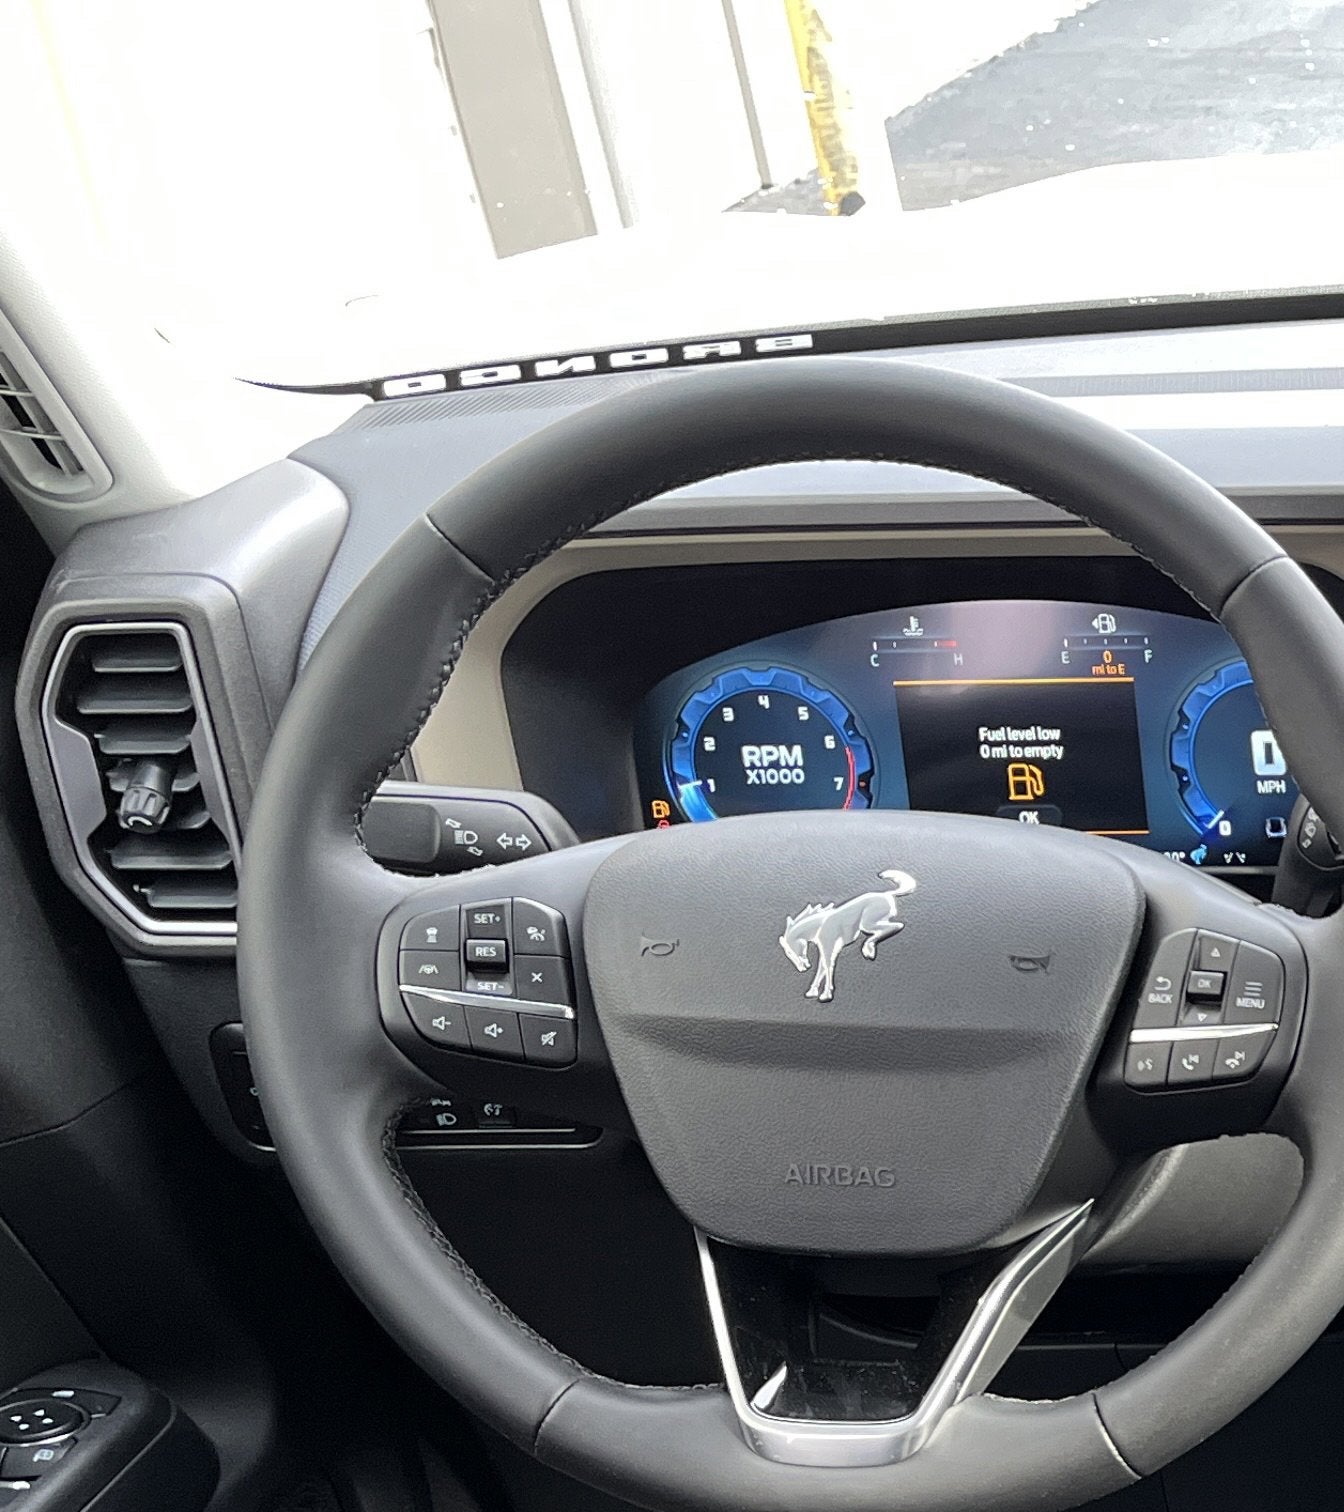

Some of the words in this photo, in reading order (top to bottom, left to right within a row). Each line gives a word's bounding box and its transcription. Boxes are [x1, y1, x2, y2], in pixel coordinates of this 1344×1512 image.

[870, 653, 880, 667] C
[954, 654, 963, 665] H
[1061, 650, 1071, 664] E
[1103, 649, 1113, 664] 0
[1144, 649, 1153, 664] F
[1092, 663, 1105, 676] mi
[1106, 663, 1117, 675] to
[1118, 662, 1125, 676] E
[758, 695, 770, 709] 4
[722, 707, 735, 722] 3
[797, 706, 809, 721] 5
[979, 726, 1006, 742] Fuel
[1006, 726, 1036, 741] level
[1036, 725, 1061, 741] low
[703, 737, 716, 751] 2
[824, 735, 836, 749] 6
[741, 744, 804, 768] RPM
[980, 744, 990, 759] 0
[991, 744, 1008, 759] mi
[1008, 744, 1023, 759] to
[1024, 744, 1065, 760] empty
[746, 768, 805, 786] X1000
[833, 777, 844, 791] 7
[707, 778, 716, 793] 1
[1256, 780, 1287, 795] MPH
[1019, 810, 1039, 824] OK
[1219, 820, 1232, 837] 0
[475, 946, 497, 958] RES
[1197, 978, 1211, 989] OK
[1148, 993, 1174, 1004] BACK
[1236, 997, 1266, 1010] MENU
[784, 1163, 896, 1188] AIRBAG
